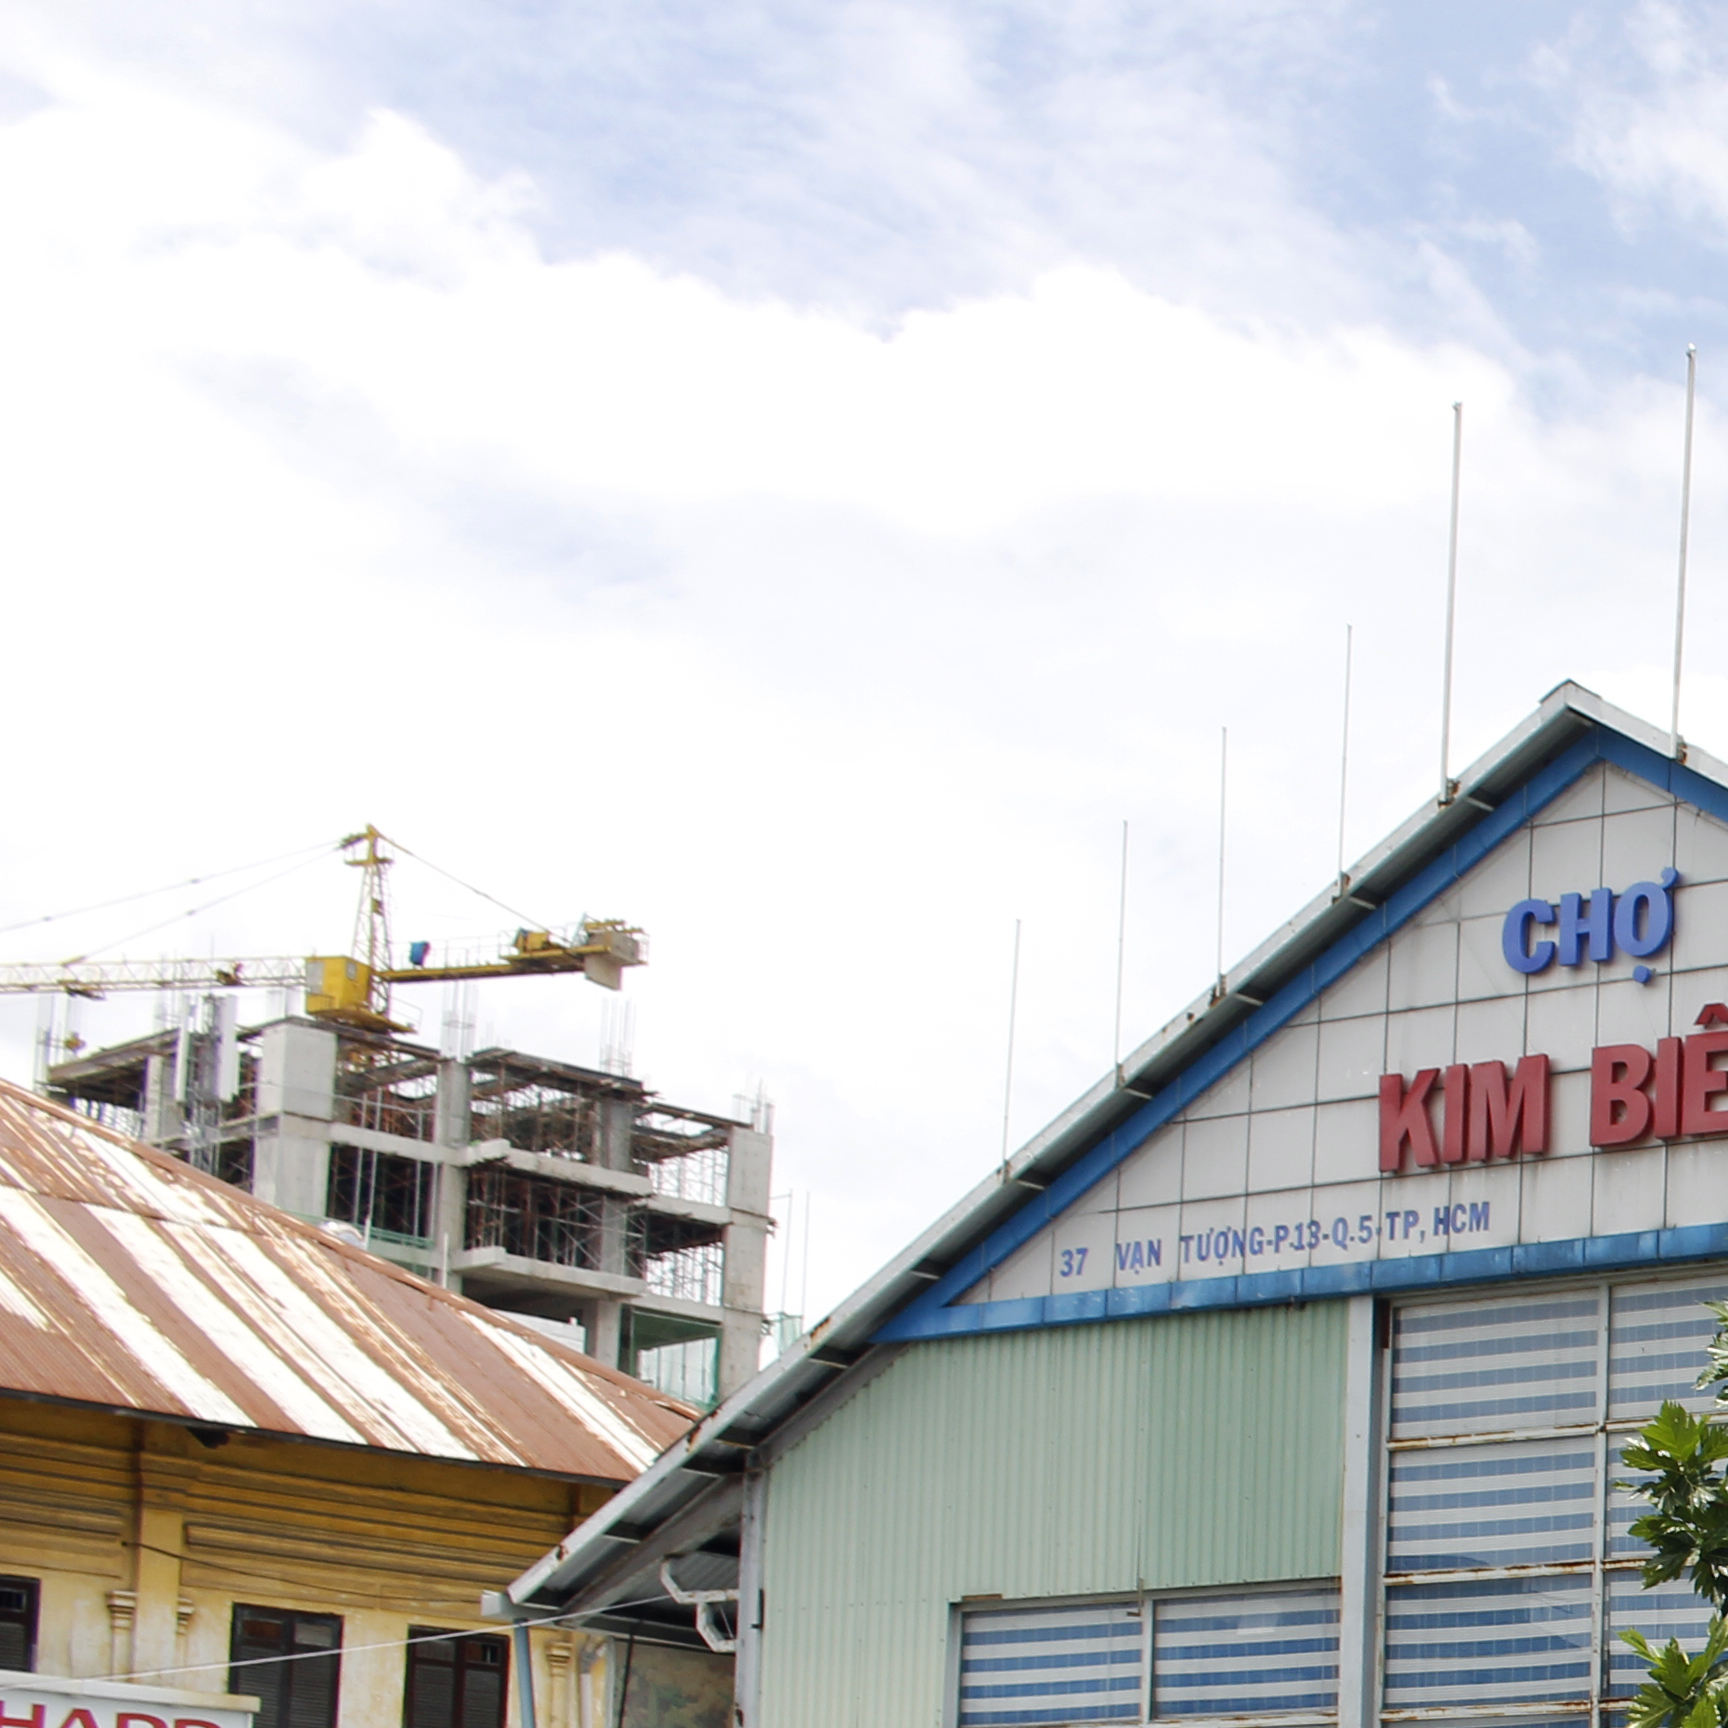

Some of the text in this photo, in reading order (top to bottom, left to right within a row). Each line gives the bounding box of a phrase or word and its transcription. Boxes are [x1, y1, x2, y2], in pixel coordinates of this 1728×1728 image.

[1502, 866, 1680, 983] CHỢ
[1378, 1052, 1549, 1172] KIM
[1058, 1246, 1088, 1278] 37
[1116, 1237, 1162, 1277] VẠN
[1432, 1200, 1490, 1237] HCM
